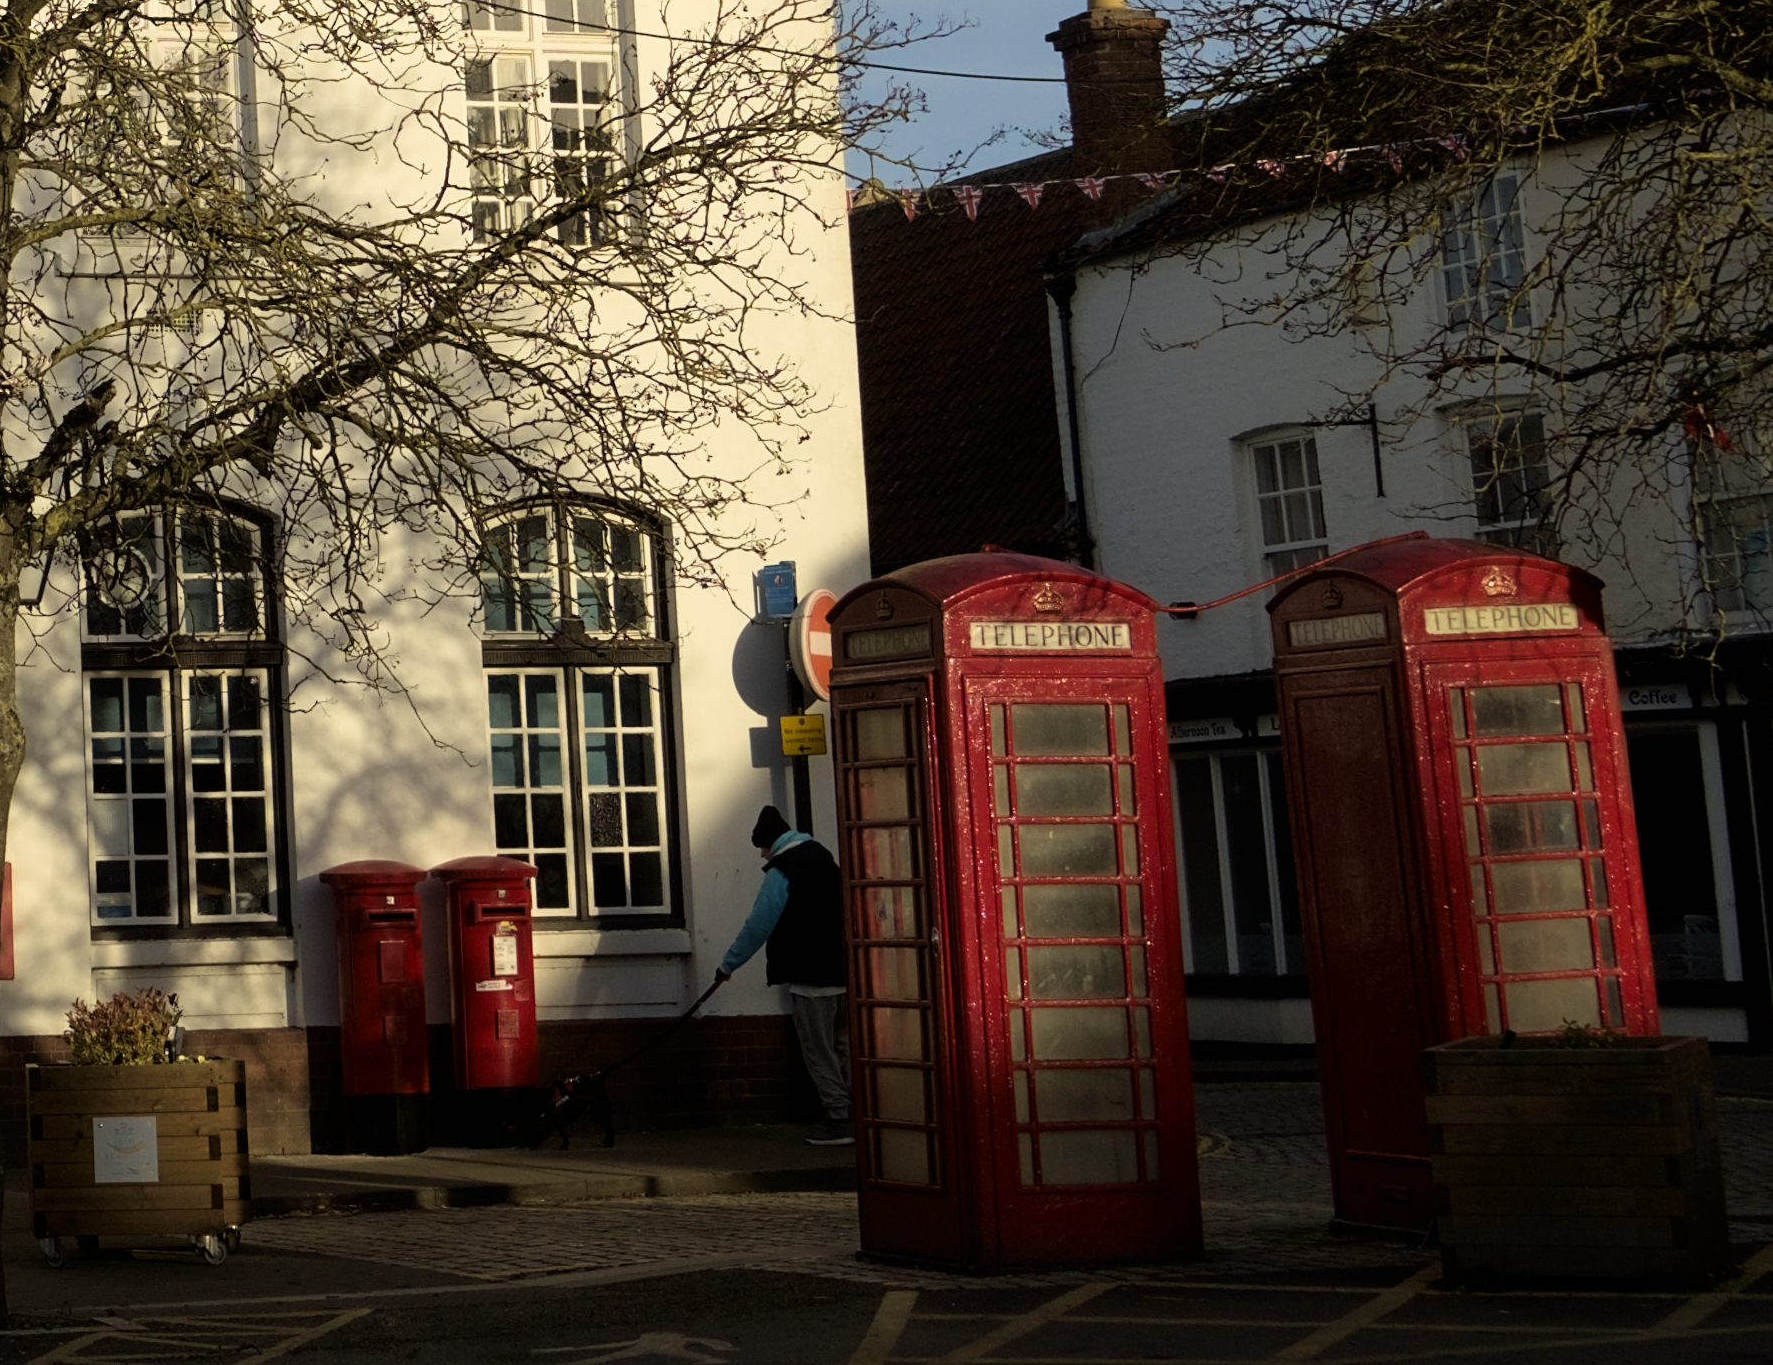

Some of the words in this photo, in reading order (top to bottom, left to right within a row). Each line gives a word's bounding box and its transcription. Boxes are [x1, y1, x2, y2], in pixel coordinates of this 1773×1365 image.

[1292, 613, 1384, 644] TELEPHONE
[1429, 605, 1572, 632] TELEPHONE
[977, 625, 1125, 647] TELEPHONE
[1628, 689, 1677, 705] Coffee
[1169, 725, 1210, 739] Afternoon
[1211, 722, 1226, 736] Tea
